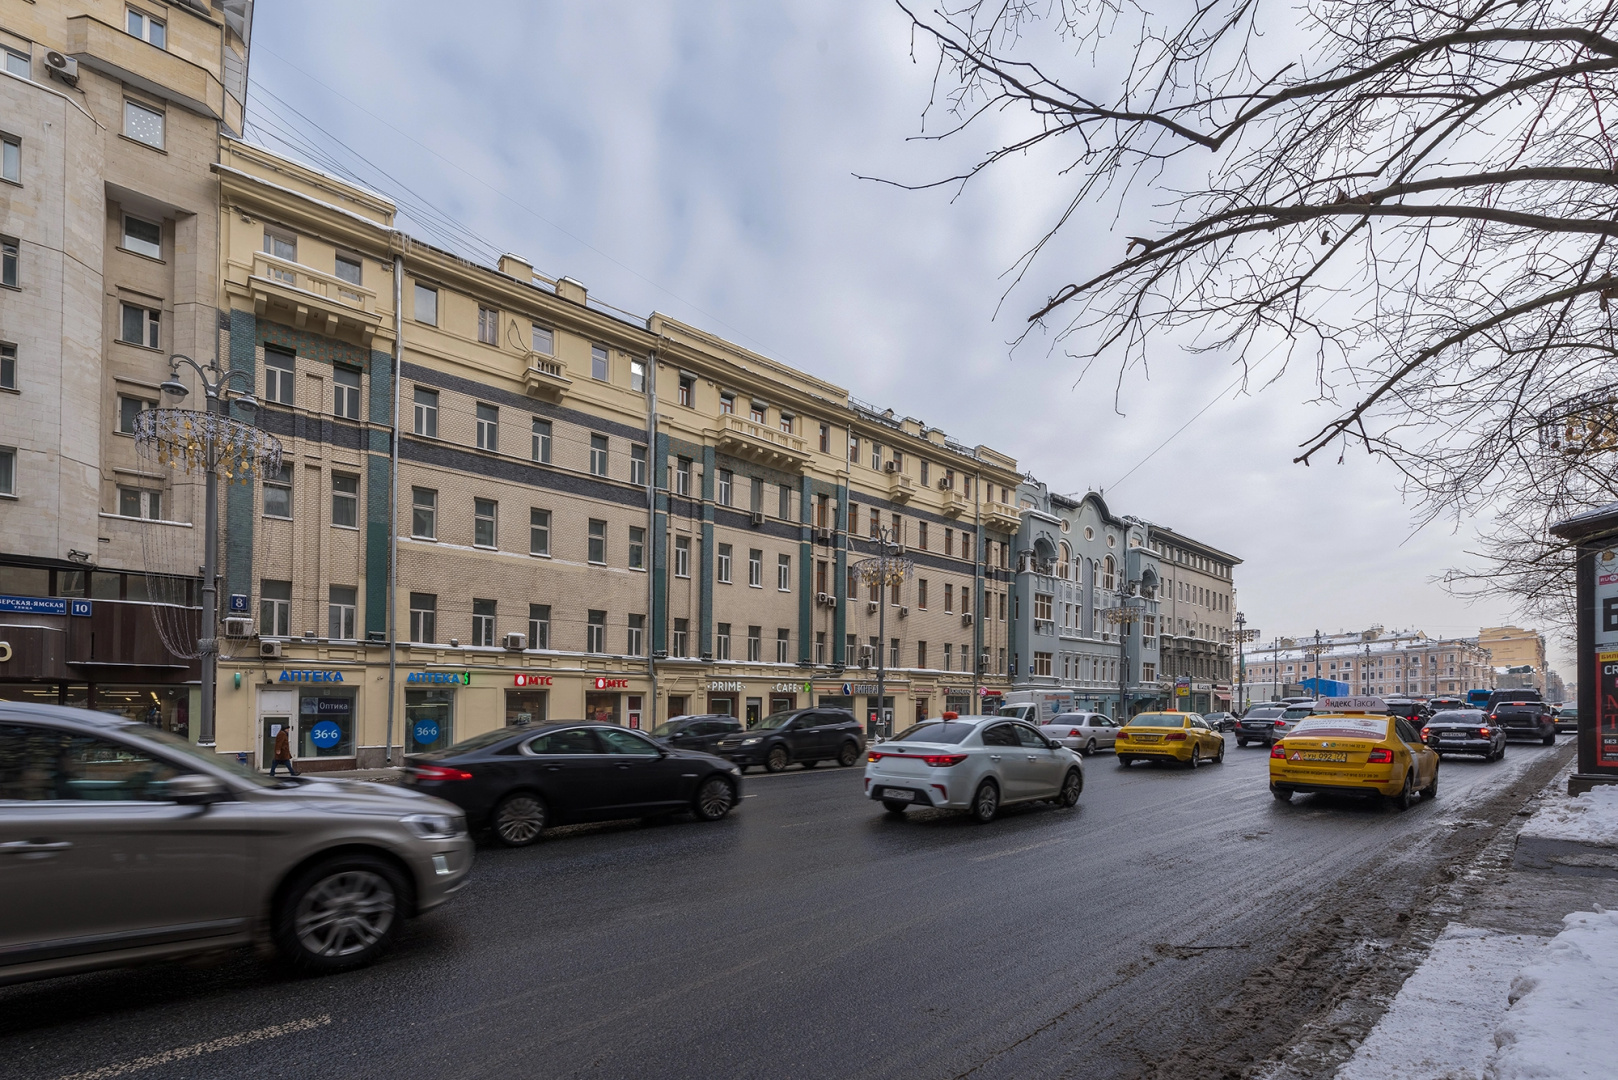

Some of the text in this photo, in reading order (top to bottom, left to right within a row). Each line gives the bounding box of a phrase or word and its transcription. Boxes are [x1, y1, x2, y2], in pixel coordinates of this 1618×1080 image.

[236, 598, 243, 607] 8
[75, 604, 88, 612] 10
[279, 670, 344, 682] АПТЕКА
[407, 672, 460, 683] АПТЕКА
[528, 676, 552, 686] МТС
[607, 680, 628, 688] МТС
[711, 681, 797, 692] PRIME CAFE
[854, 684, 886, 694] БИНБАК
[320, 702, 348, 710] Оптика
[1324, 698, 1376, 708] Яндекс Такси
